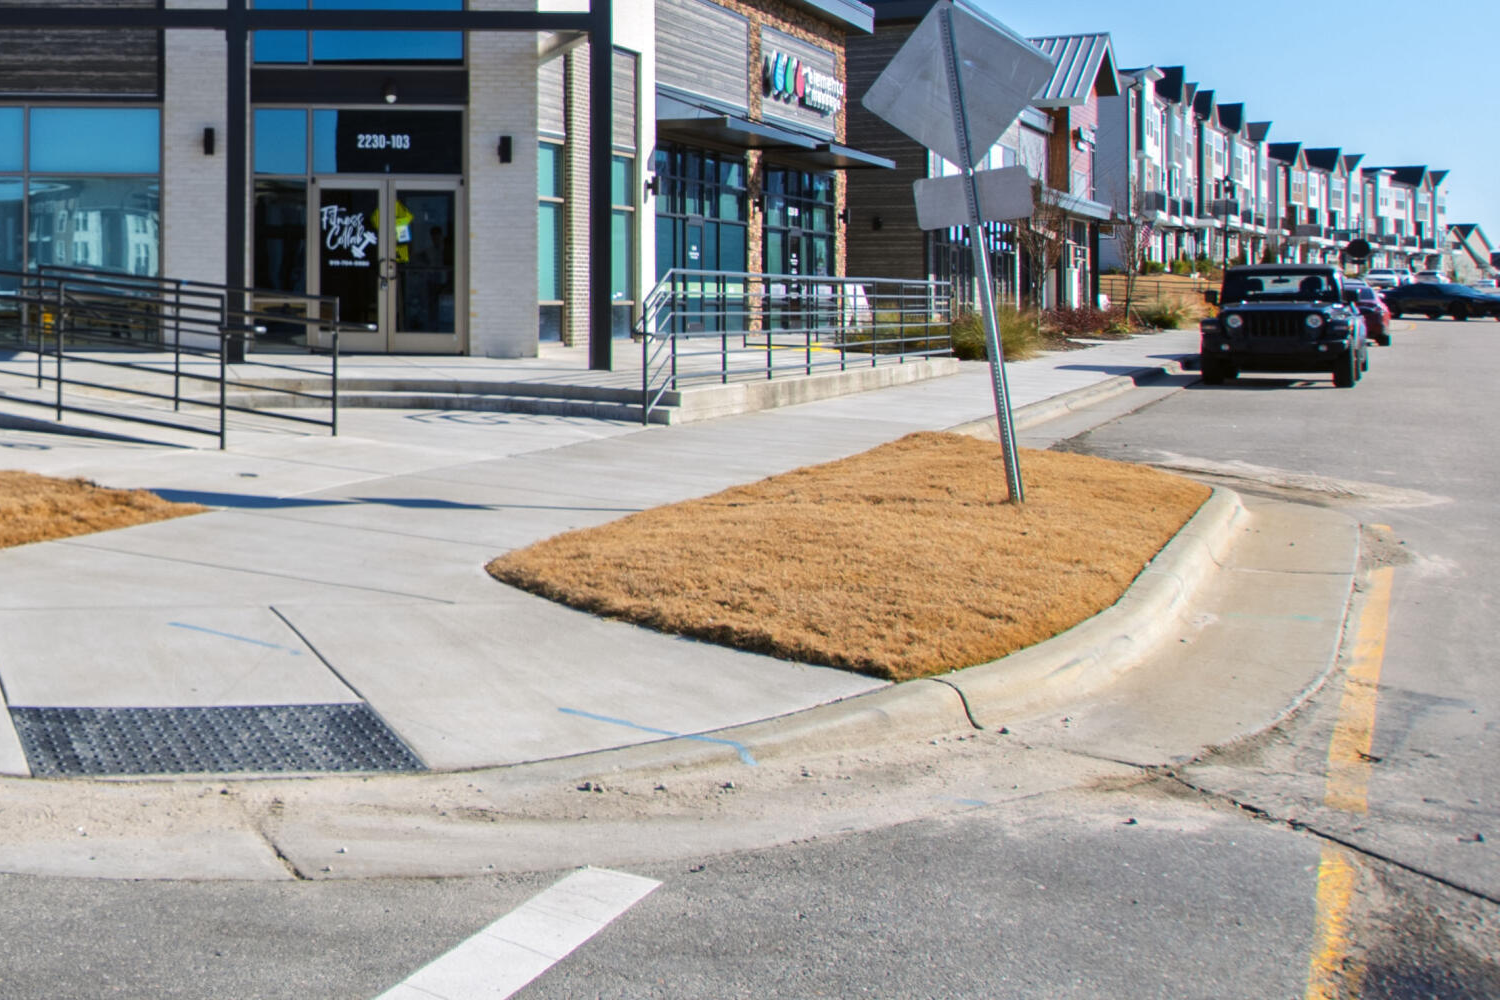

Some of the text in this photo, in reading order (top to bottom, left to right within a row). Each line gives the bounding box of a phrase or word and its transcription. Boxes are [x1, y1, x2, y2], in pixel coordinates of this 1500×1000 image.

[357, 134, 410, 149] 2230-103
[320, 205, 364, 230] Fitness
[326, 224, 364, 249] Collab
